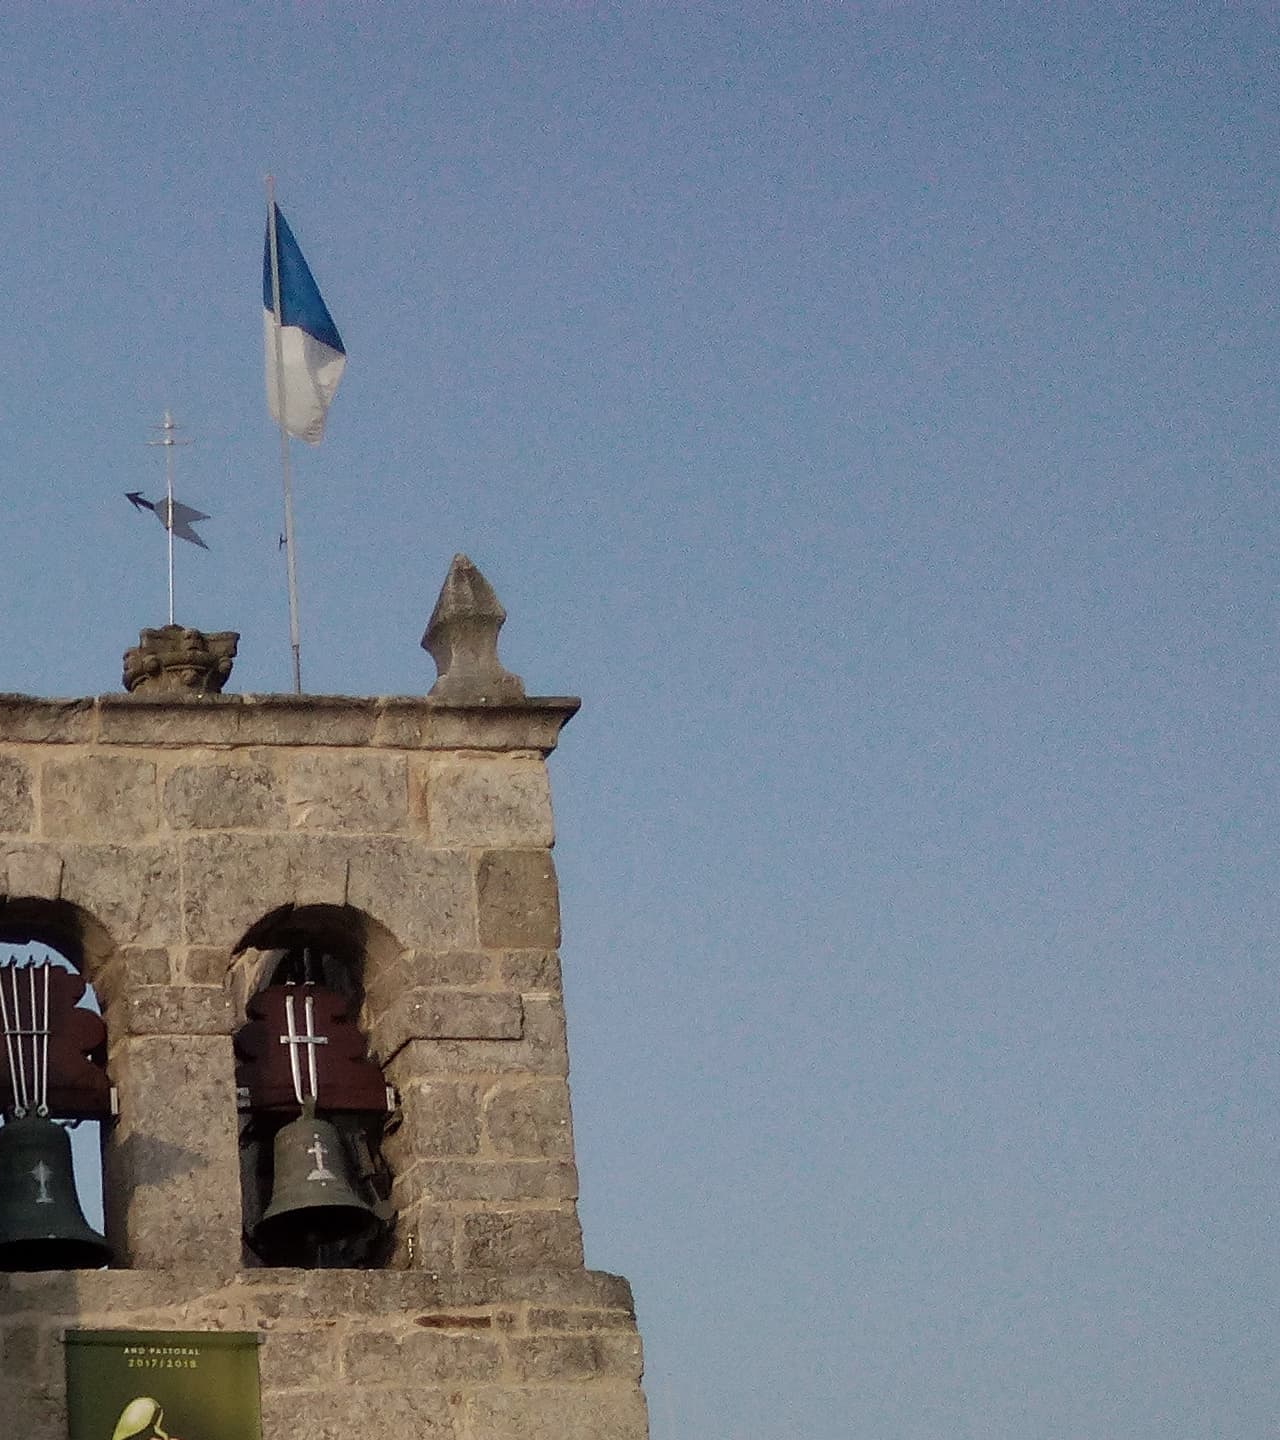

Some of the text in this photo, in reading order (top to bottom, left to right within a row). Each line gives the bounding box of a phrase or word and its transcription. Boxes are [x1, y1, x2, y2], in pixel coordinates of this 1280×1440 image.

[123, 1347, 200, 1355] ANO PASTORAL
[128, 1359, 197, 1369] 2017/2018
